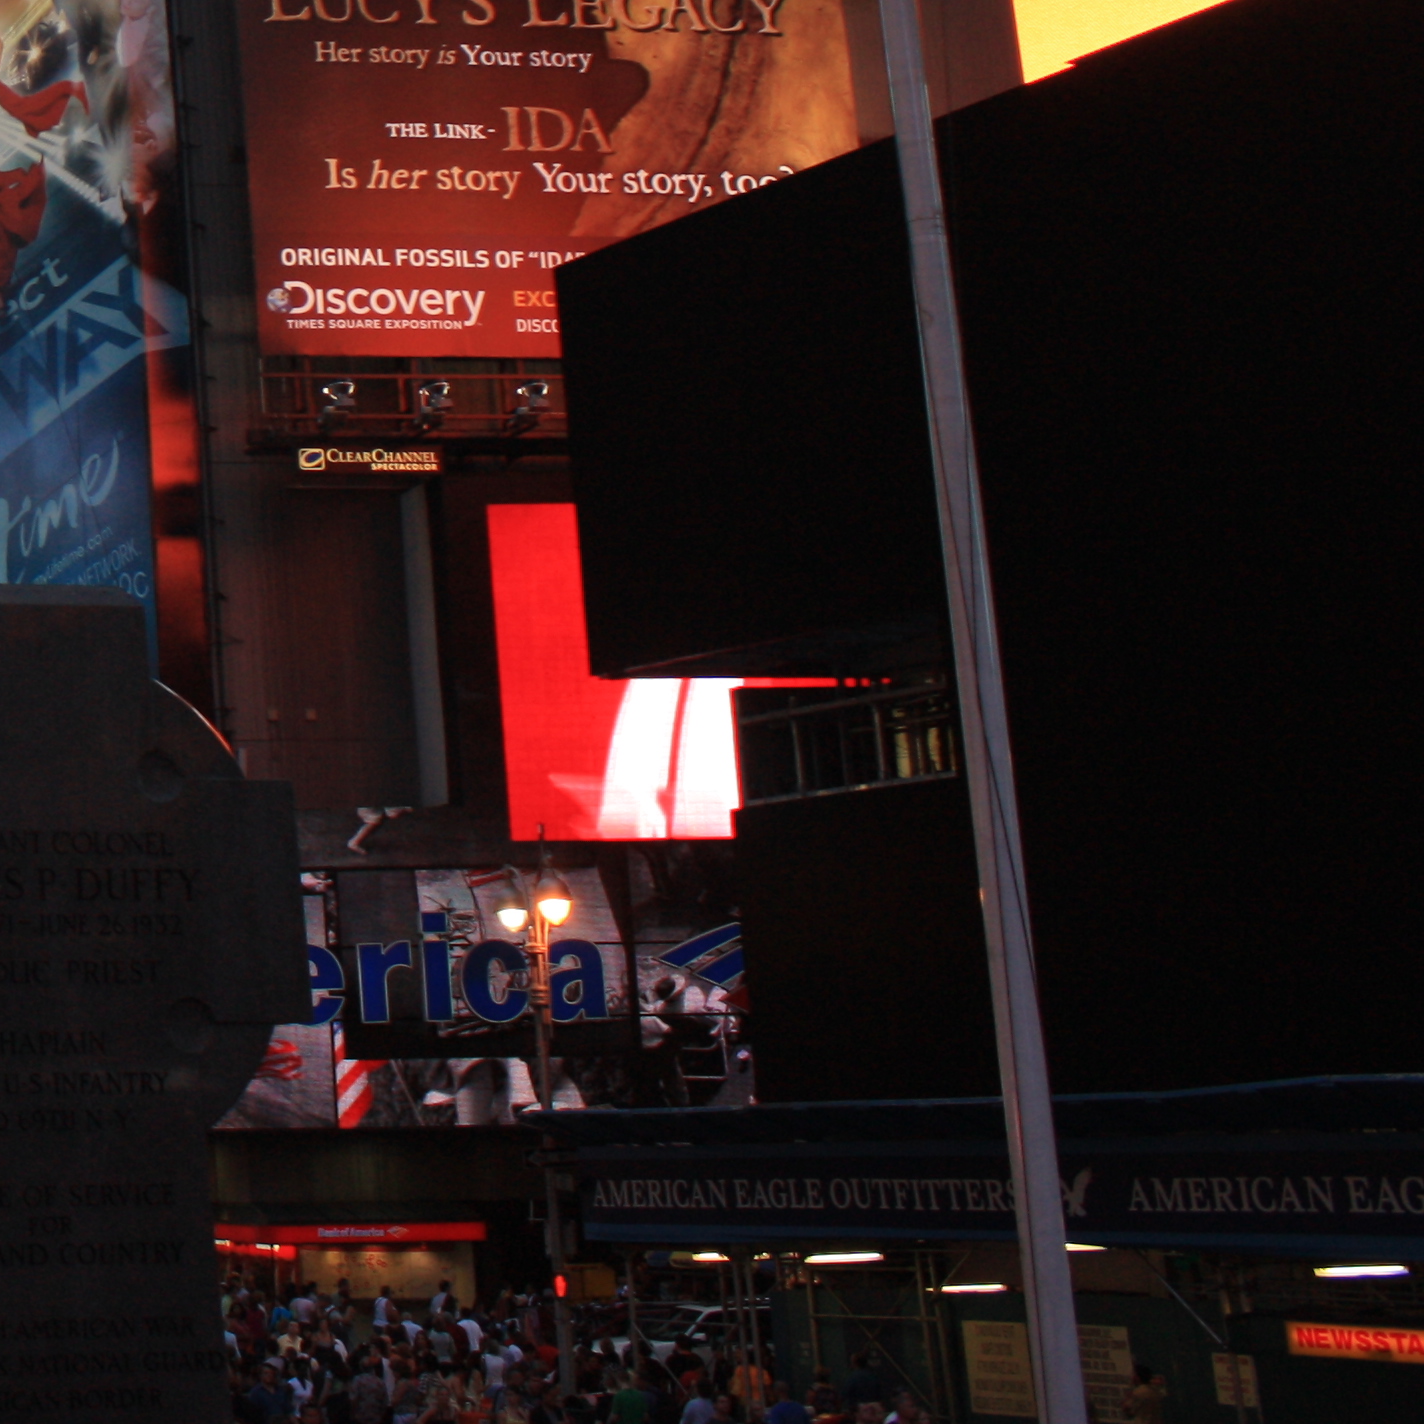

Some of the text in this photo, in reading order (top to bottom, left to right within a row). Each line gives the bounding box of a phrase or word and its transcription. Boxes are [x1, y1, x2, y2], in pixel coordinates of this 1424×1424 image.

[315, 42, 591, 73] Her story is Your story
[386, 123, 428, 139] THE
[500, 106, 612, 154] IDA
[325, 159, 713, 202] Is her story Your story,
[281, 248, 523, 268] ORIGINAL FOSSILS OF
[284, 280, 485, 326] Discovery
[287, 320, 462, 330] TIMES SQUARE EXPOSITION
[52, 831, 174, 857] COLONEL
[75, 867, 201, 902] DUFFY
[67, 958, 163, 986] PRIEST
[23, 1185, 56, 1208] OF
[69, 1183, 177, 1206] SERVICE
[593, 1179, 825, 1209] AMERICAN EAGLE
[1129, 1177, 1334, 1213] AMERICAN
[59, 1242, 186, 1266] COUNTRY
